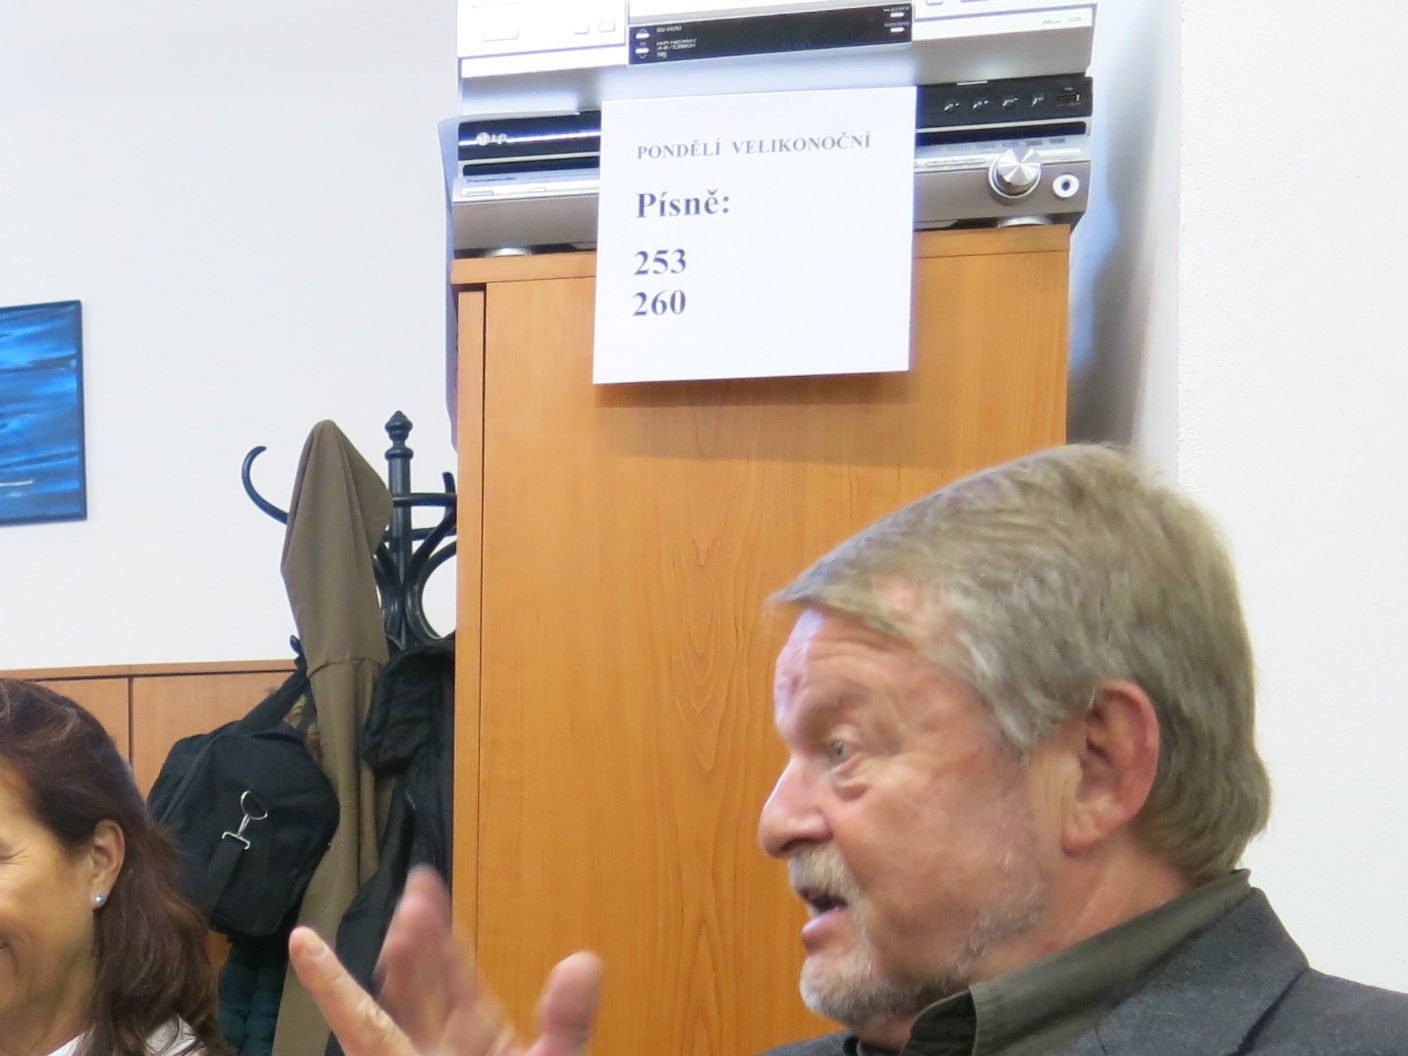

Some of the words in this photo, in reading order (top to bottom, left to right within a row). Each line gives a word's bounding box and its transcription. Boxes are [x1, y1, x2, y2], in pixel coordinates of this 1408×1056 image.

[637, 138, 721, 160] PONDĚLÍ
[732, 131, 871, 155] VELIKONOČNÍ
[637, 188, 730, 218] Písně:
[633, 249, 687, 276] 253
[632, 290, 687, 316] 260
